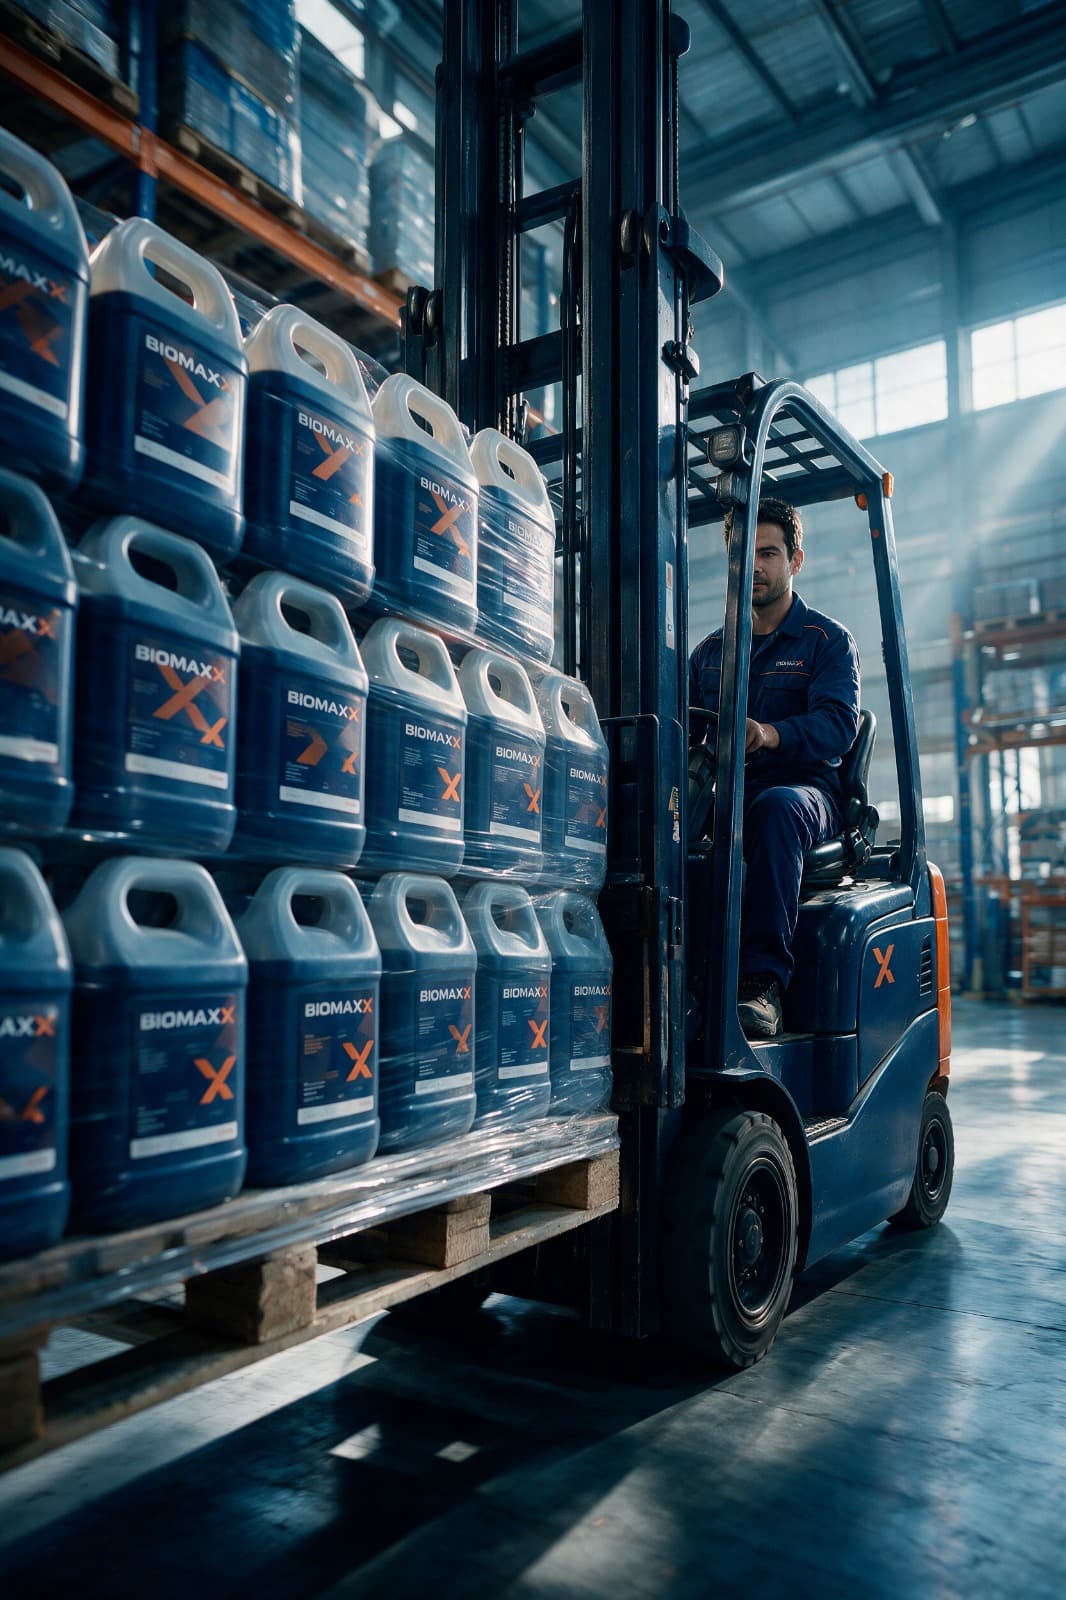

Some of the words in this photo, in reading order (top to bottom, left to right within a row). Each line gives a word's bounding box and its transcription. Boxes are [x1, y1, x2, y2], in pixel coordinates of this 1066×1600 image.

[145, 334, 234, 394] BIOMAXX
[298, 412, 364, 457] BIOMAXX
[420, 476, 473, 514] BIOMAXX
[508, 520, 546, 550] BIOMAX
[135, 644, 226, 685] BIOMAXX
[287, 690, 360, 723] BIOMAXX
[405, 723, 461, 749] BIOMAXX
[496, 746, 541, 768] BIOMAXX
[570, 768, 607, 787] BIOMAXX
[419, 986, 472, 1003] BIOMAXX
[503, 986, 548, 999] BIOMAXX
[574, 984, 611, 996] BIOMAXX
[139, 1006, 236, 1031] BIOMAXX
[304, 998, 373, 1018] BIOMAXX
